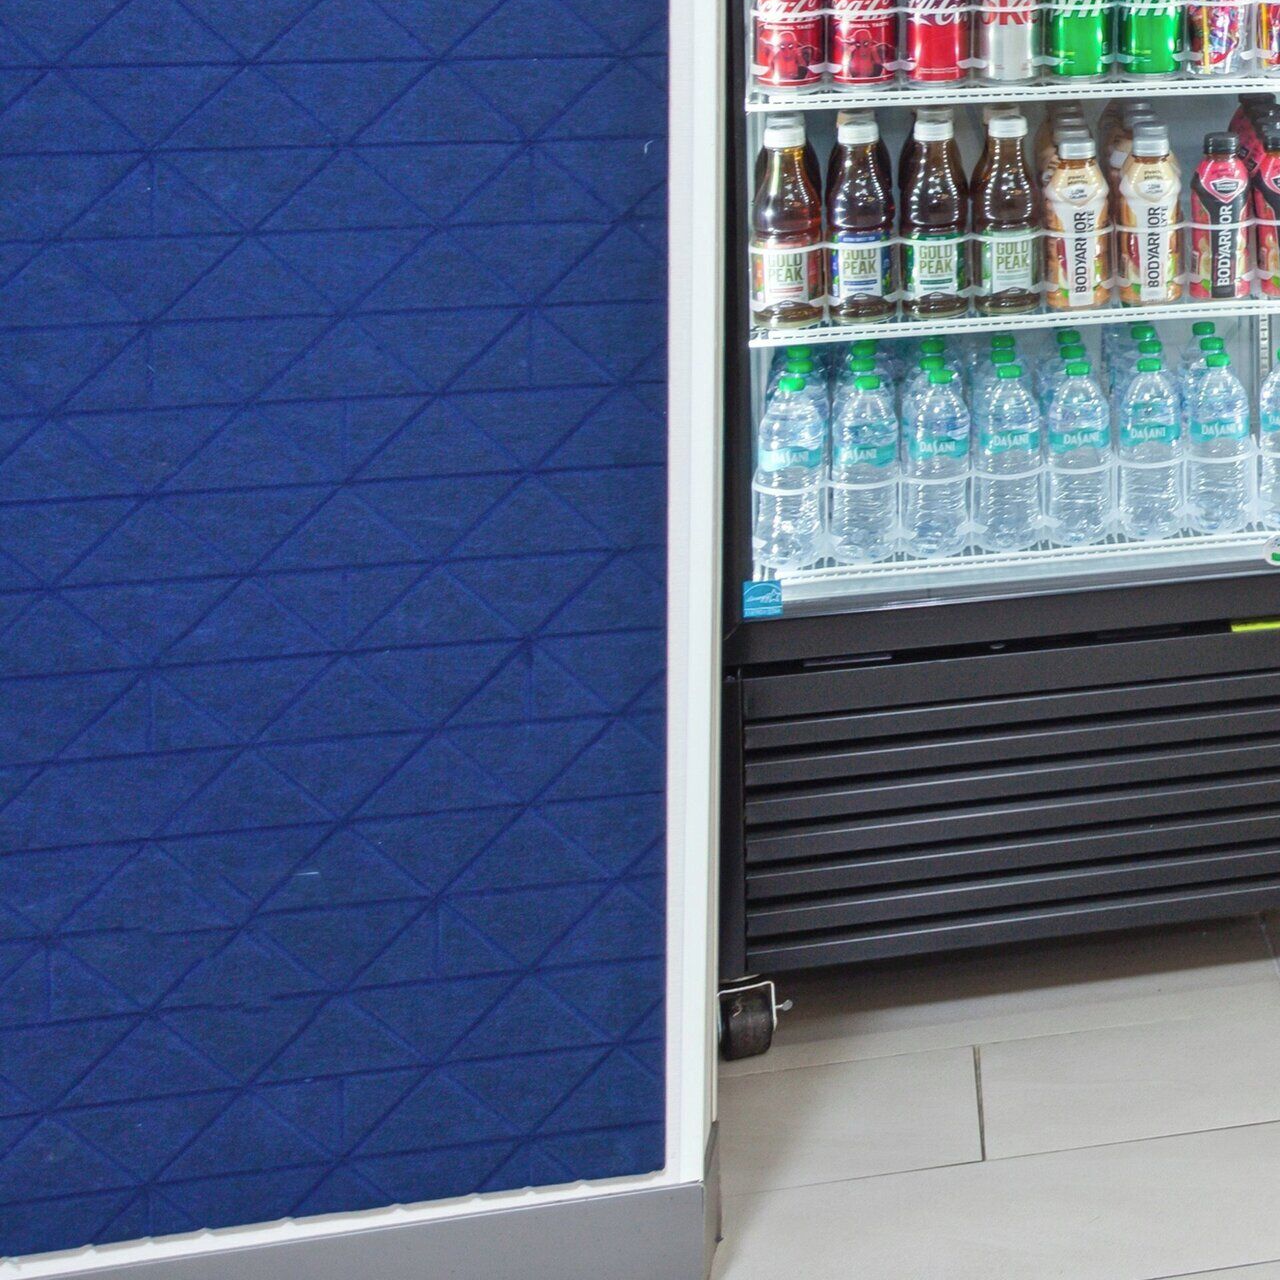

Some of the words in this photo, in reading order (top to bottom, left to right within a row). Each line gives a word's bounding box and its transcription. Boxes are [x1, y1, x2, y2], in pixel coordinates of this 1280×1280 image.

[842, 247, 877, 260] GOLD
[919, 244, 953, 259] GOLD
[996, 240, 1031, 255] GOLD
[768, 252, 803, 267] GOLD
[919, 259, 953, 275] PEAK
[996, 255, 1031, 270] PEAK
[768, 268, 804, 283] PEAK
[842, 260, 877, 276] PEAK
[1130, 427, 1166, 442] DASANI
[1201, 421, 1237, 437] DASANI
[993, 433, 1030, 448] DASANI
[1063, 431, 1101, 446] DASANI
[919, 440, 956, 455] DASANI
[842, 449, 878, 465] DASANI
